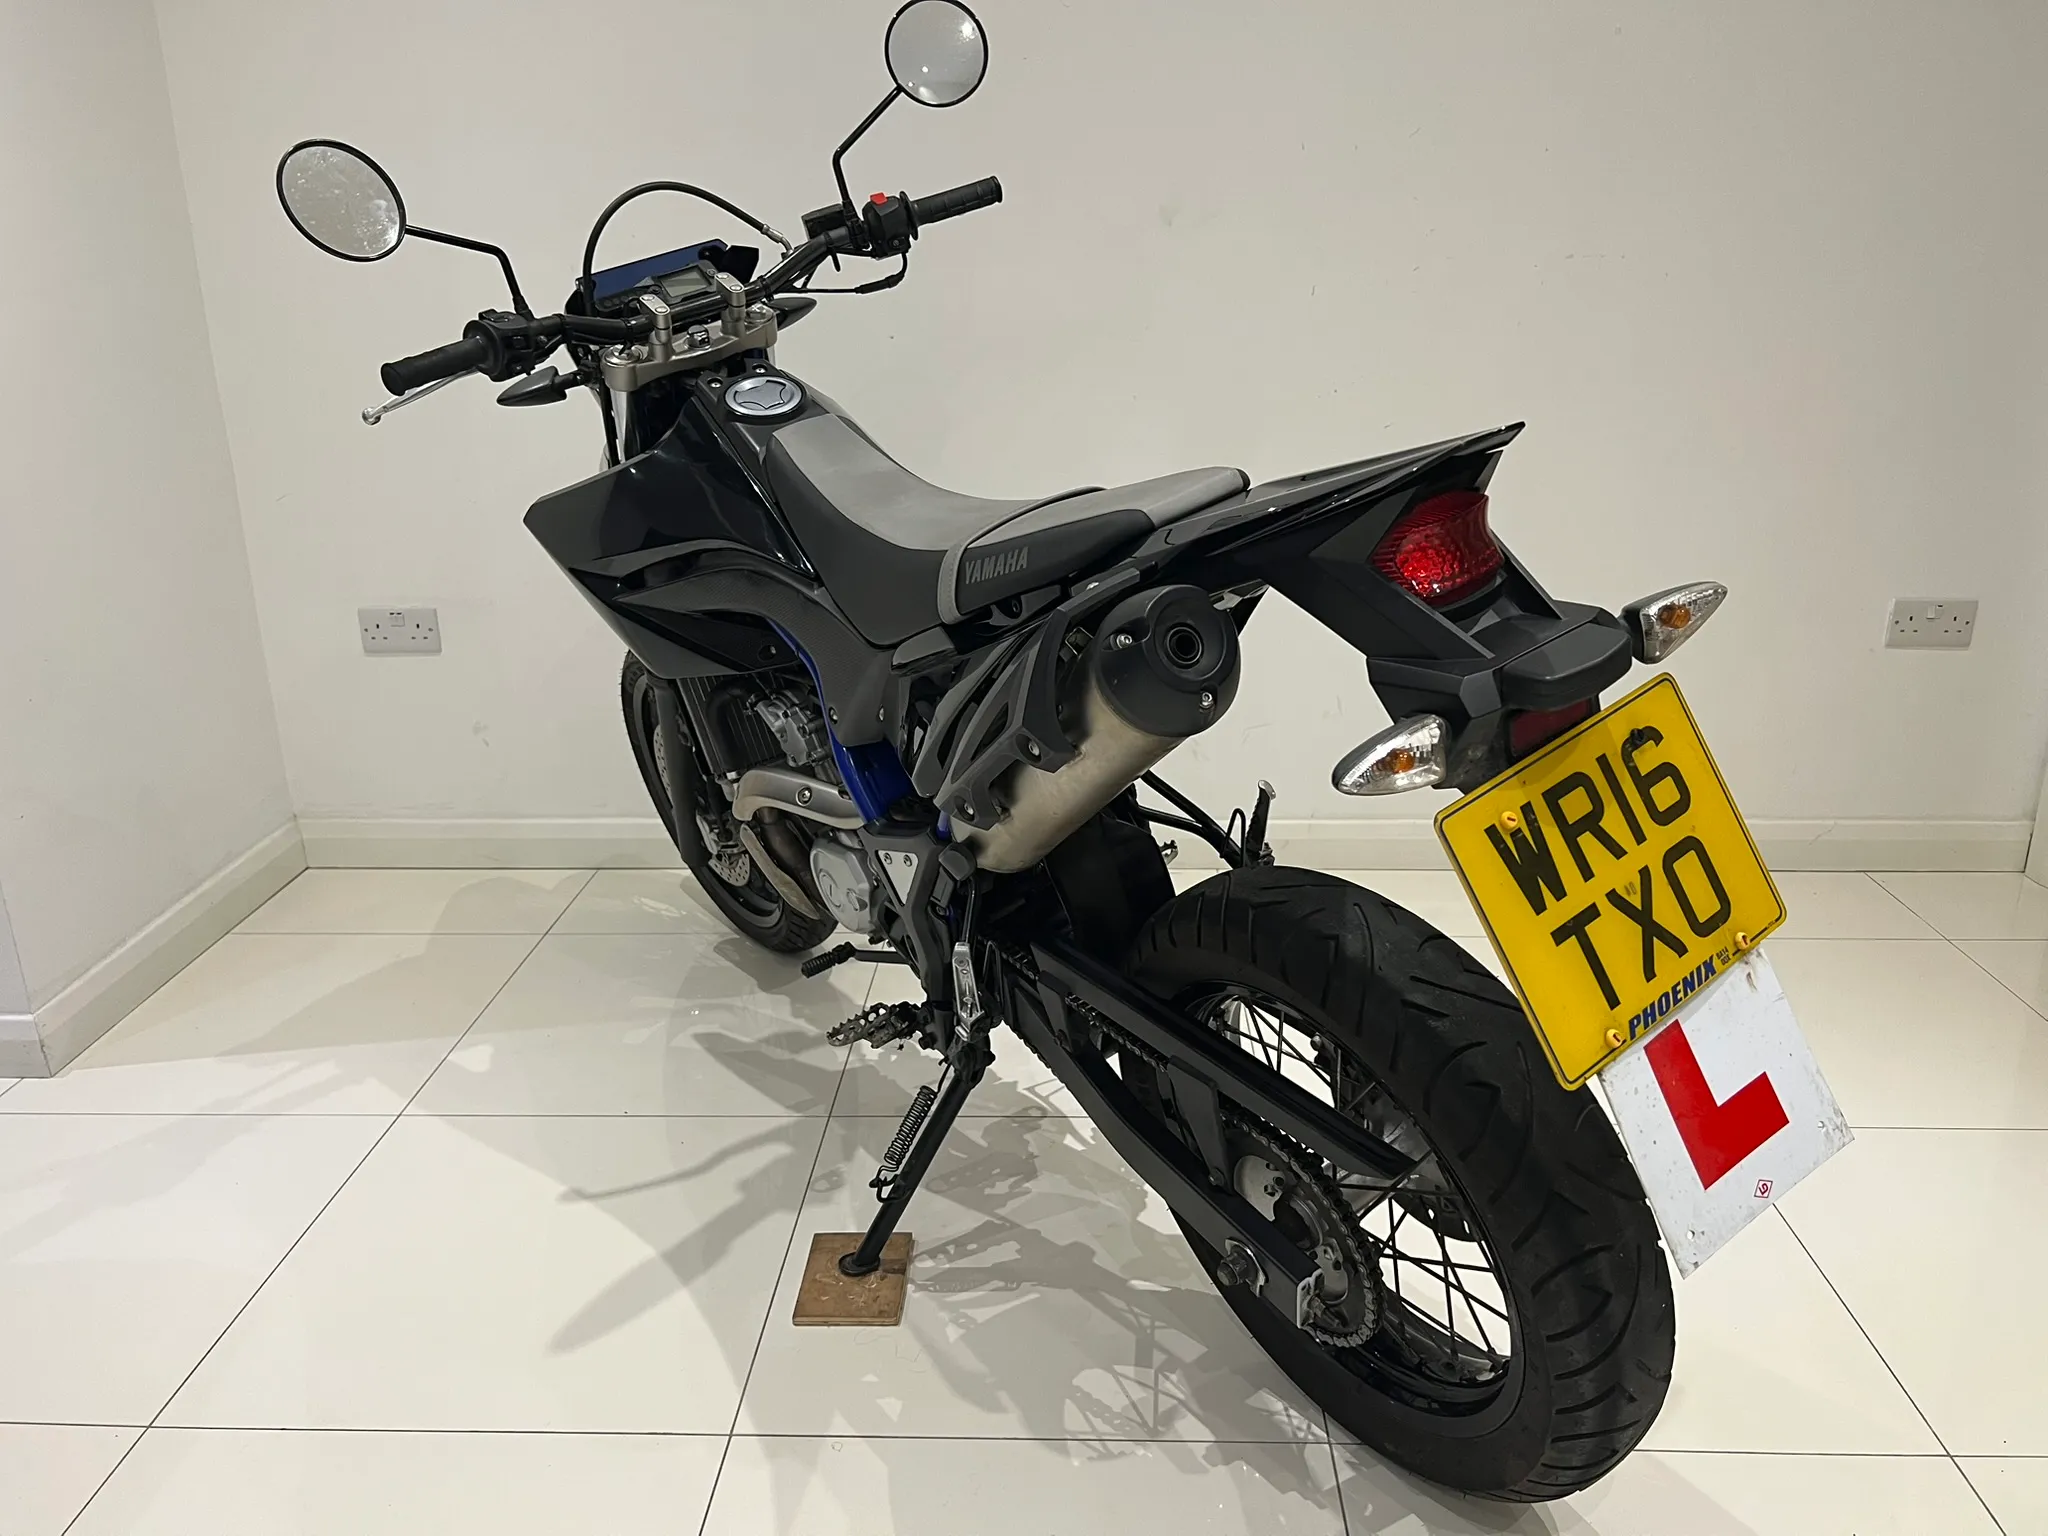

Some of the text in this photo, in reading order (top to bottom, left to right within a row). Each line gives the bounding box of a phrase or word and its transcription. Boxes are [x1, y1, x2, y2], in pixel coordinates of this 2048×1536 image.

[965, 546, 1028, 584] YAMAHA
[1484, 725, 1691, 916] WR16
[1550, 835, 1732, 1010] TXO
[1628, 954, 1717, 1041] PHOENIX
[1643, 1018, 1790, 1190] L
